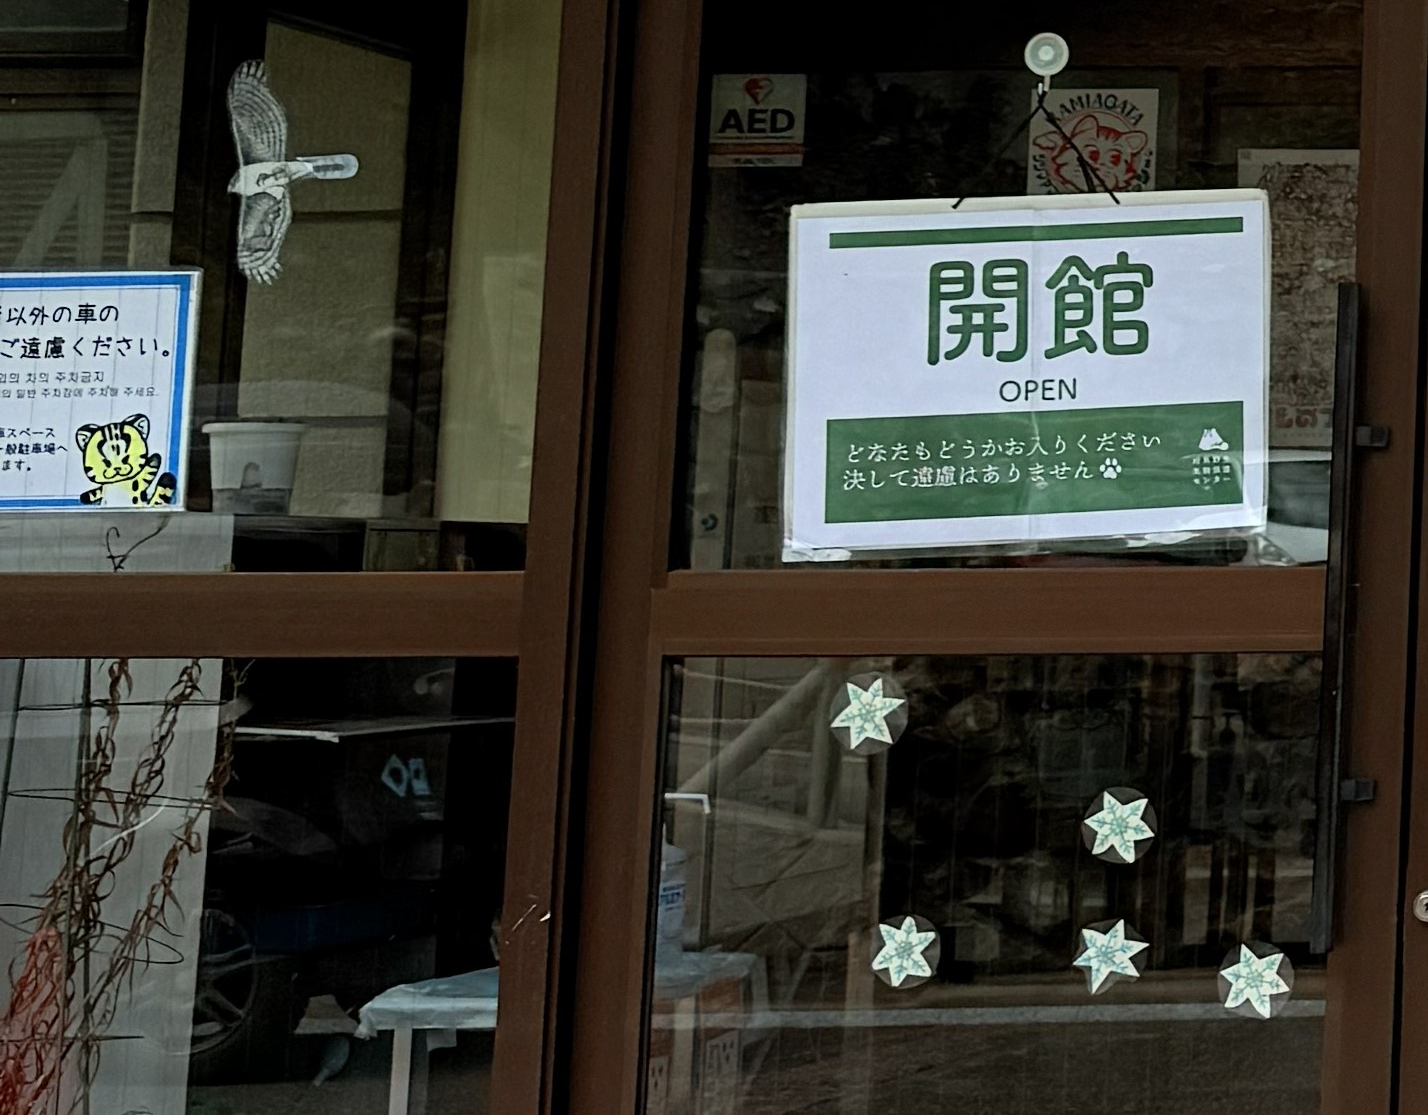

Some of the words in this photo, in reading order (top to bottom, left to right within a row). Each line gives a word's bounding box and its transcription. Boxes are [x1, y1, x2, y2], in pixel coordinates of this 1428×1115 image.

[717, 109, 794, 132] AED
[0, 302, 119, 326] 以外の車の
[927, 251, 1154, 365] 開館
[0, 336, 170, 359] ご遠慮ください。
[999, 378, 1077, 402] OPEN
[847, 433, 1162, 463] どなたもどうかお入りください
[843, 459, 1094, 491] 決して遠慮はありません
